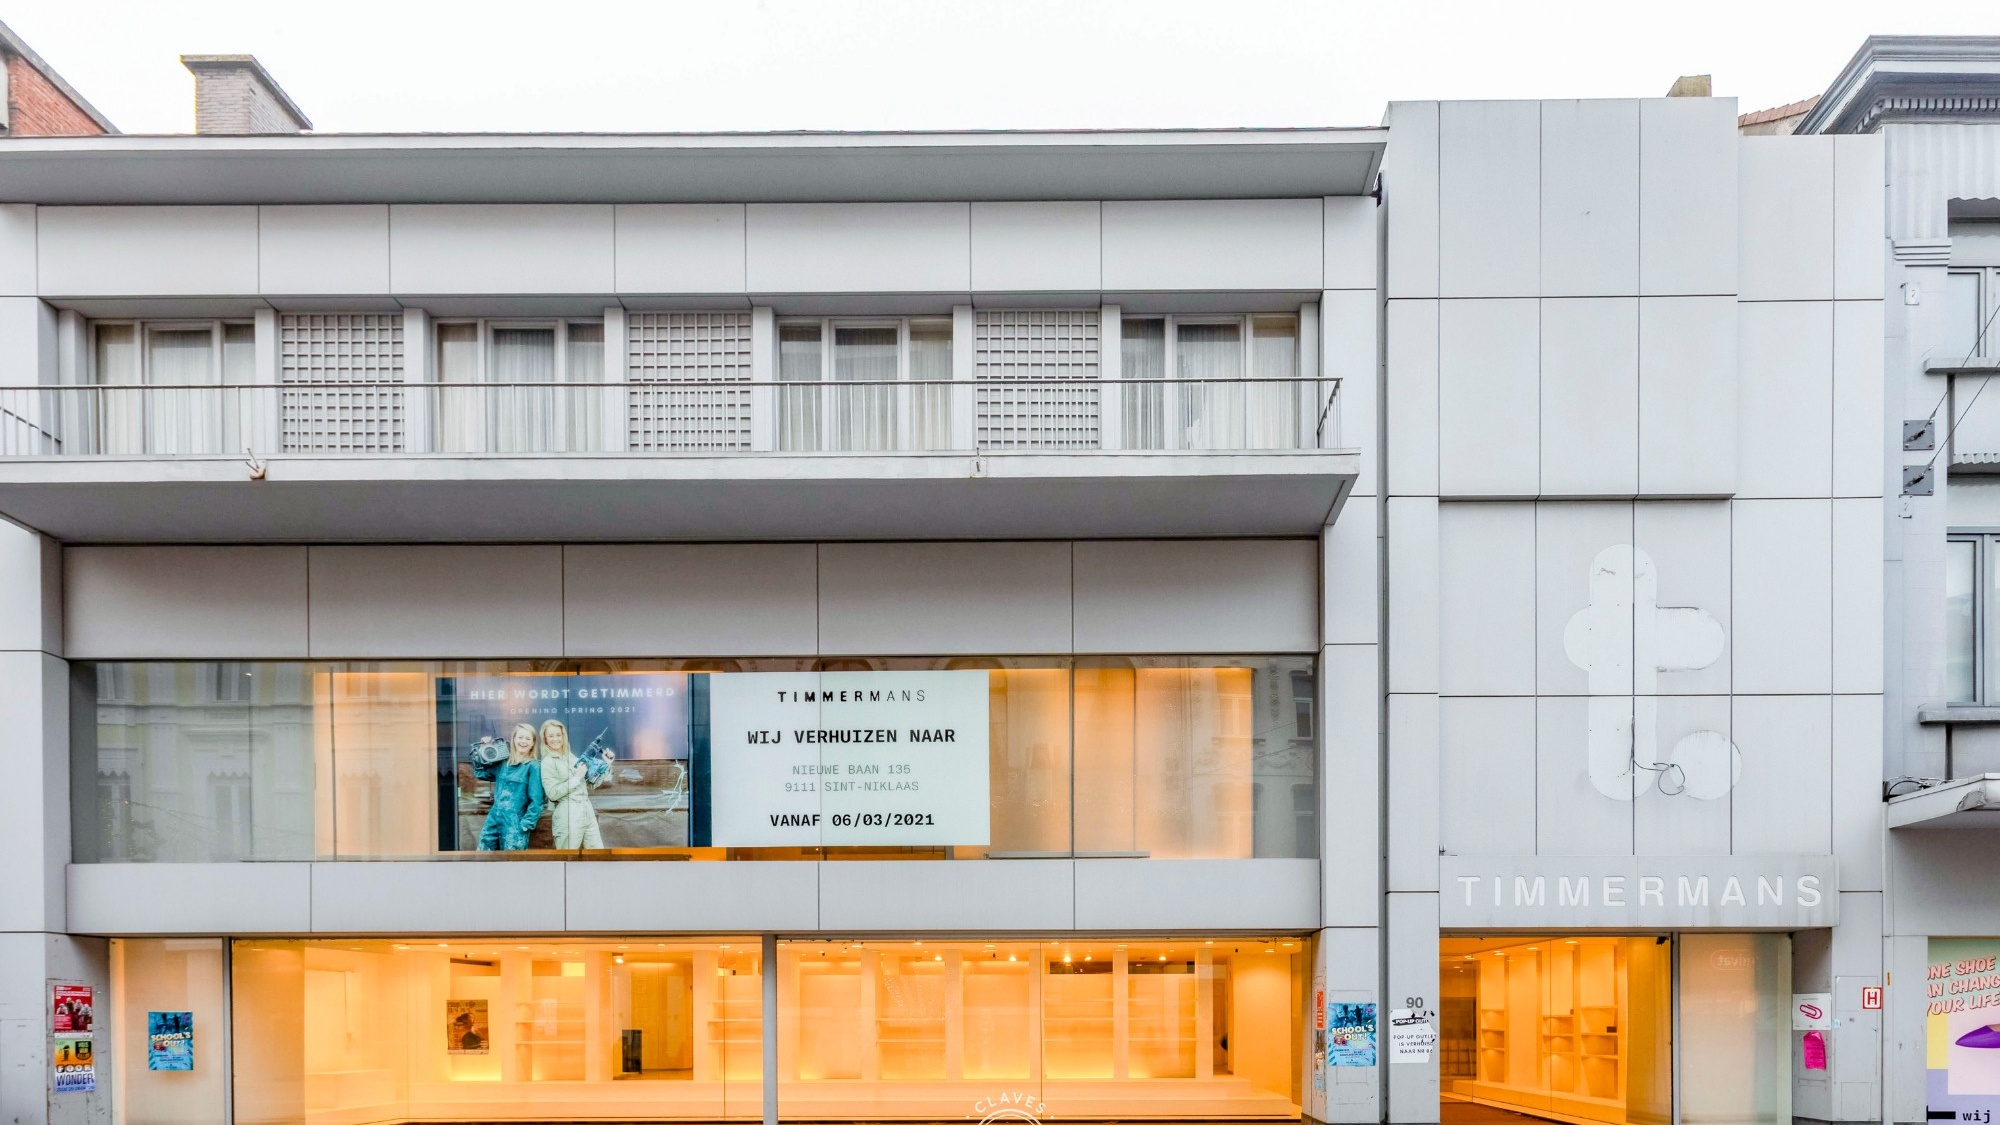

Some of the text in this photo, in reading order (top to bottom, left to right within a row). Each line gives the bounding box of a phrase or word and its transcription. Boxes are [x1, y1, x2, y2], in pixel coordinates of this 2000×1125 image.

[470, 687, 675, 701] HIER WORDT GETIMMERD
[777, 689, 926, 703] TIMMERMANS
[510, 707, 558, 715] OPENING
[564, 706, 604, 714] SPRING
[747, 729, 956, 744] WIJ VERHUIZEN NAAR
[792, 764, 911, 775] NIEUWE BAAN 135
[784, 781, 919, 792] 9111 SINT-NIKLAAS
[770, 813, 935, 827] VANAF 06/03/2021
[1456, 874, 1822, 907] TIMMERMANS
[1955, 956, 1996, 976] SHOE
[1406, 996, 1424, 1009] 90
[1867, 991, 1878, 1005] H
[1969, 992, 2000, 1009] LIFE
[151, 1031, 191, 1042] SCHOOL'S
[1331, 1024, 1374, 1035] SCHOOL'S
[1344, 1033, 1368, 1041] OUT!
[56, 1073, 95, 1087] WONDER
[1962, 1109, 1990, 1124] wij
